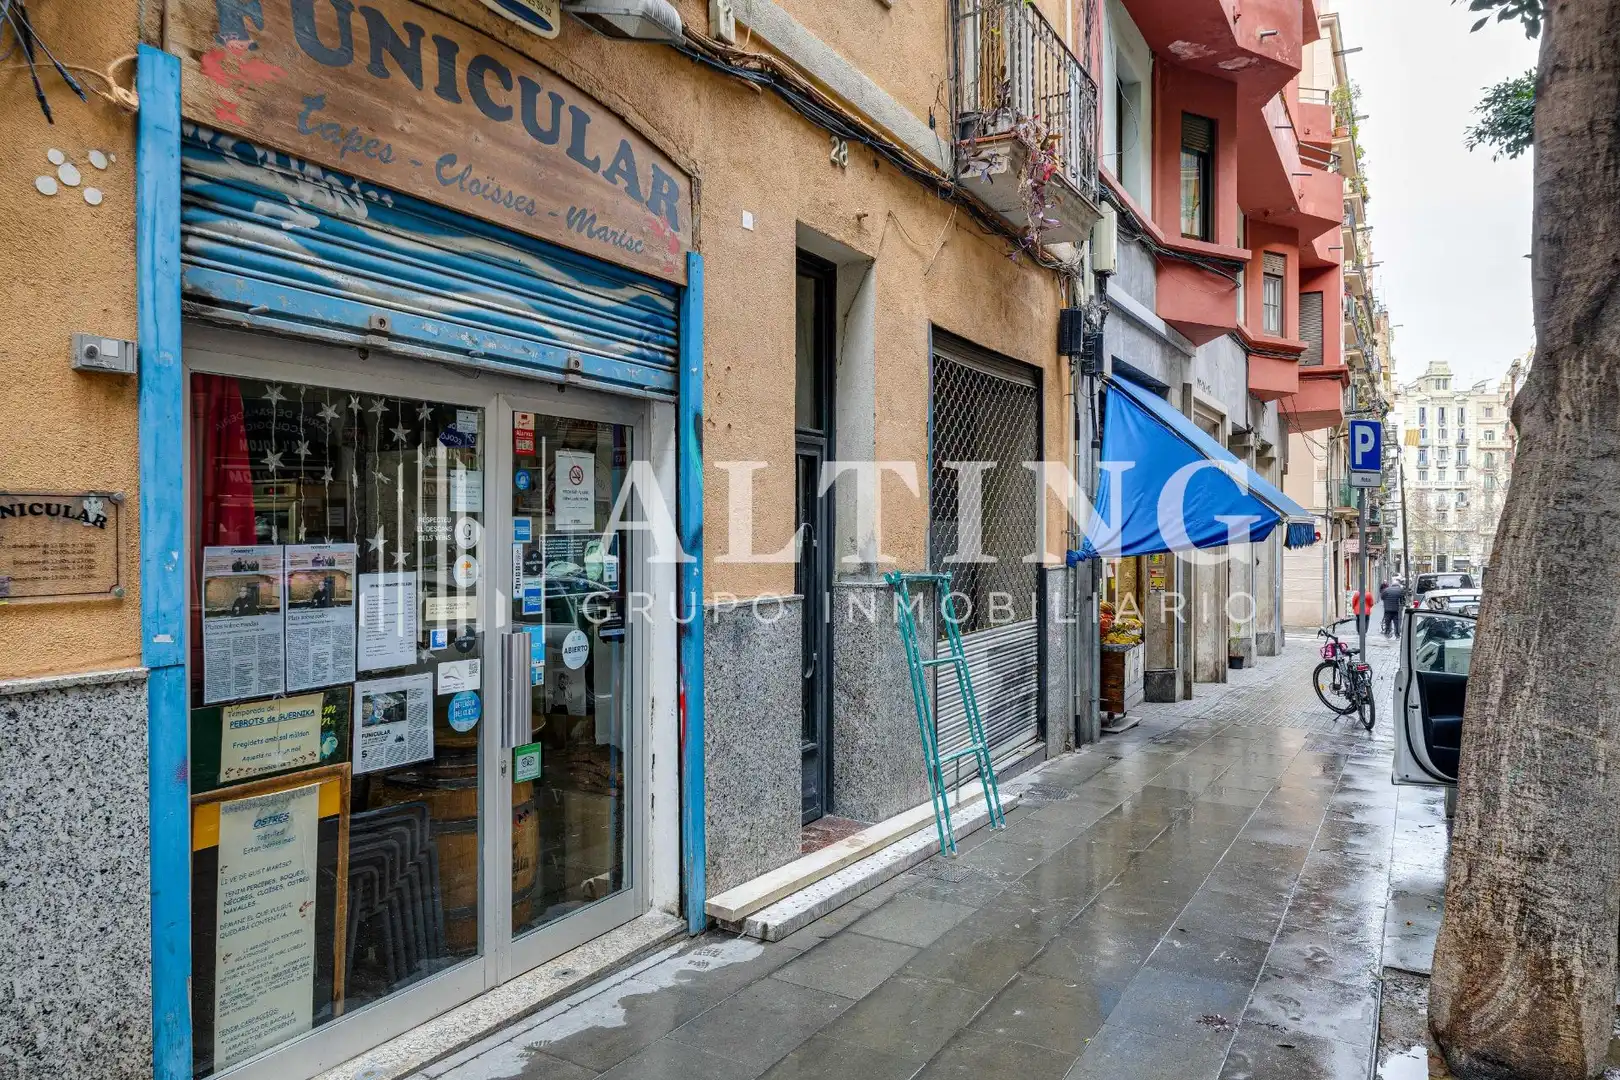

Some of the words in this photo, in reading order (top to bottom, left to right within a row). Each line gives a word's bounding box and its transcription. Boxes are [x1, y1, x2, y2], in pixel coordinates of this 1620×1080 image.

[830, 136, 848, 169] 28
[566, 205, 645, 254] Marisc
[1355, 425, 1375, 464] P
[564, 645, 588, 654] ABIERTO
[230, 716, 264, 728] PEBROTS
[253, 813, 289, 828] OSTRES
